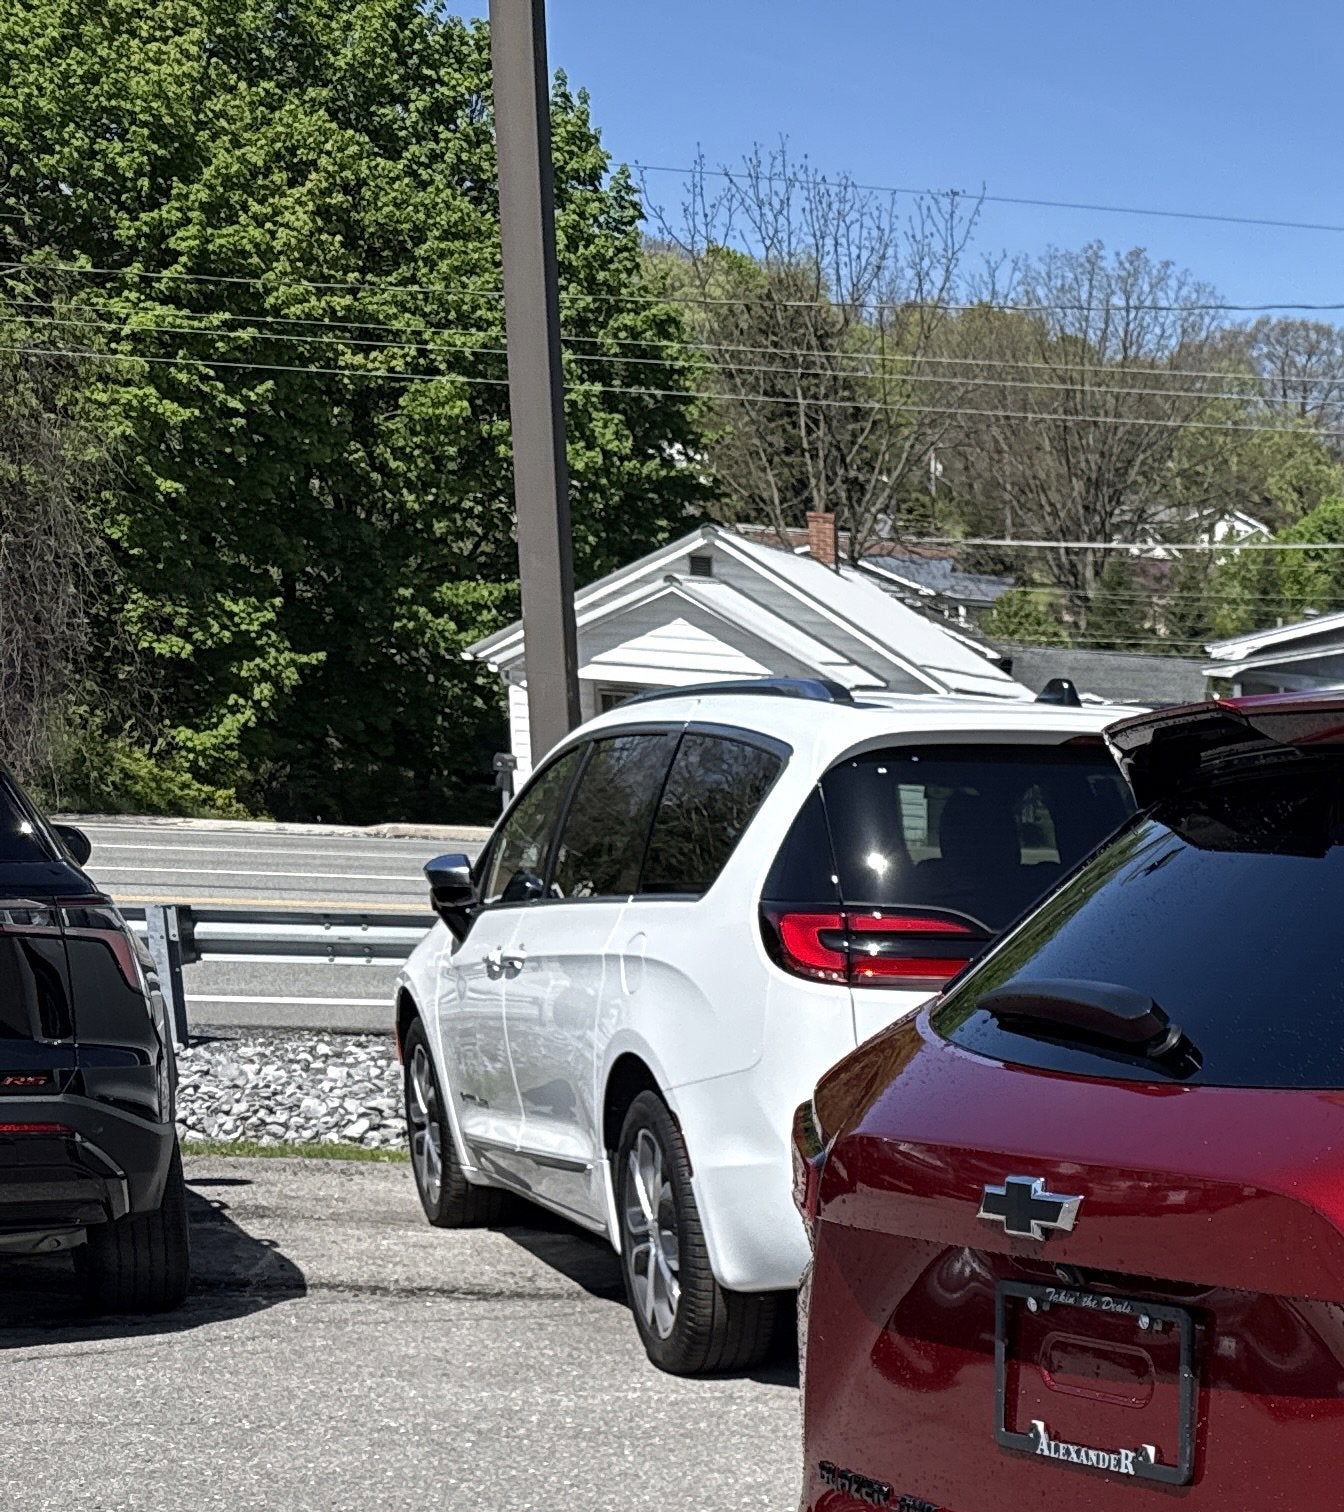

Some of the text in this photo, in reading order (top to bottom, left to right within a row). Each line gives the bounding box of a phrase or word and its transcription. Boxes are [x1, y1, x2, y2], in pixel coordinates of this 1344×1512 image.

[1082, 1295, 1098, 1308] the
[1101, 1296, 1132, 1314] Deals
[1036, 1432, 1135, 1475] ALEXANDER
